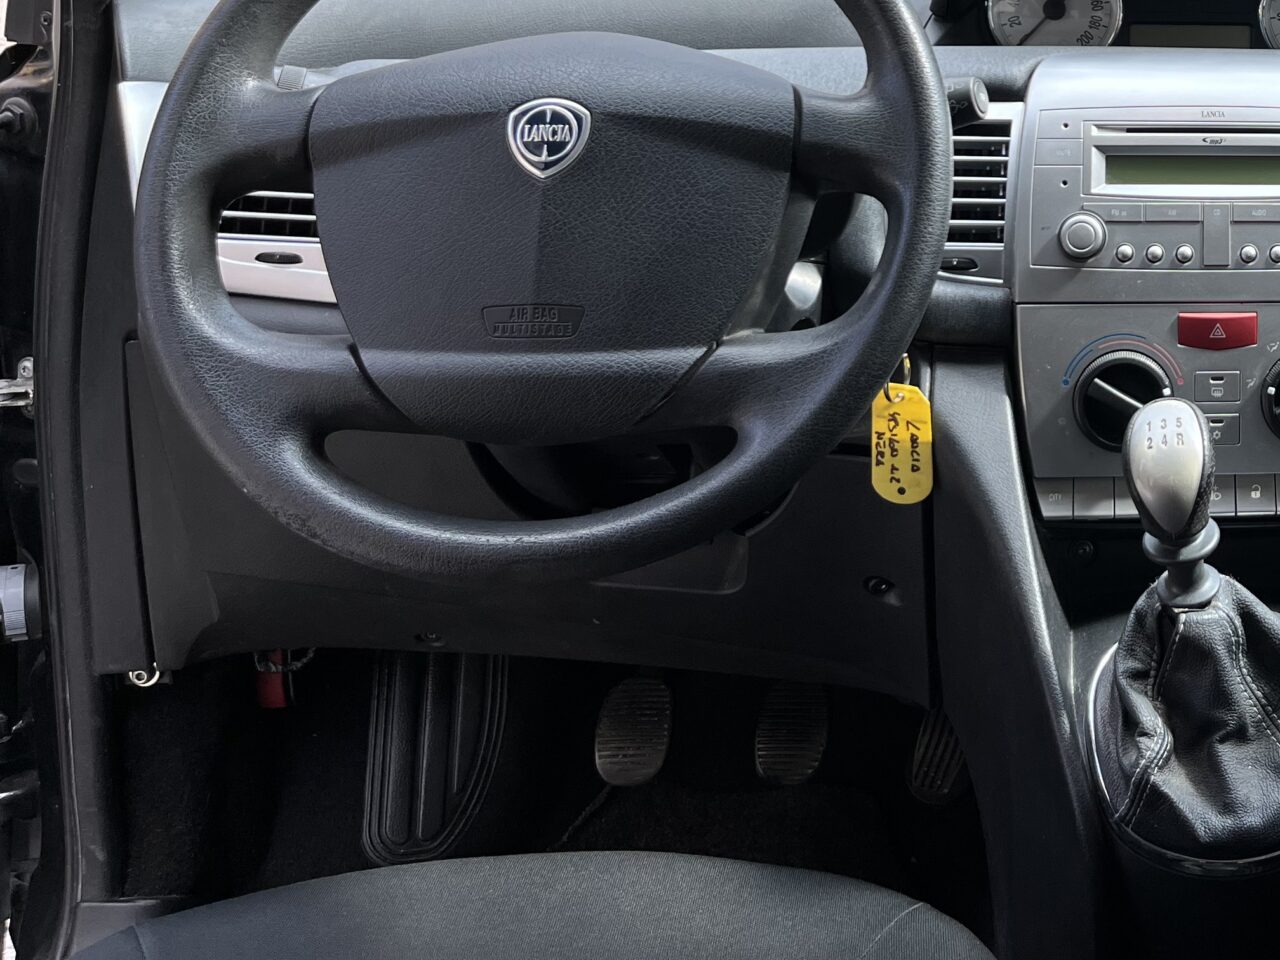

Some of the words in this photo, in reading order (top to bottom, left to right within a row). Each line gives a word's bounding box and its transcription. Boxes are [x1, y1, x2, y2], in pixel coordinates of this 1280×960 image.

[1007, 16, 1022, 28] 20
[1088, 15, 1102, 30] 180
[1076, 30, 1095, 46] 200
[1201, 110, 1225, 118] LANCIA
[523, 124, 571, 142] LANCIA
[510, 306, 529, 322] AIR
[532, 306, 558, 322] BAG
[493, 323, 572, 336] MULTISTAGE
[1146, 420, 1152, 432] 1
[1160, 418, 1167, 430] 3
[1176, 416, 1183, 428] 5
[1146, 436, 1153, 450] 2
[1161, 433, 1168, 447] 4
[1176, 432, 1184, 446] R
